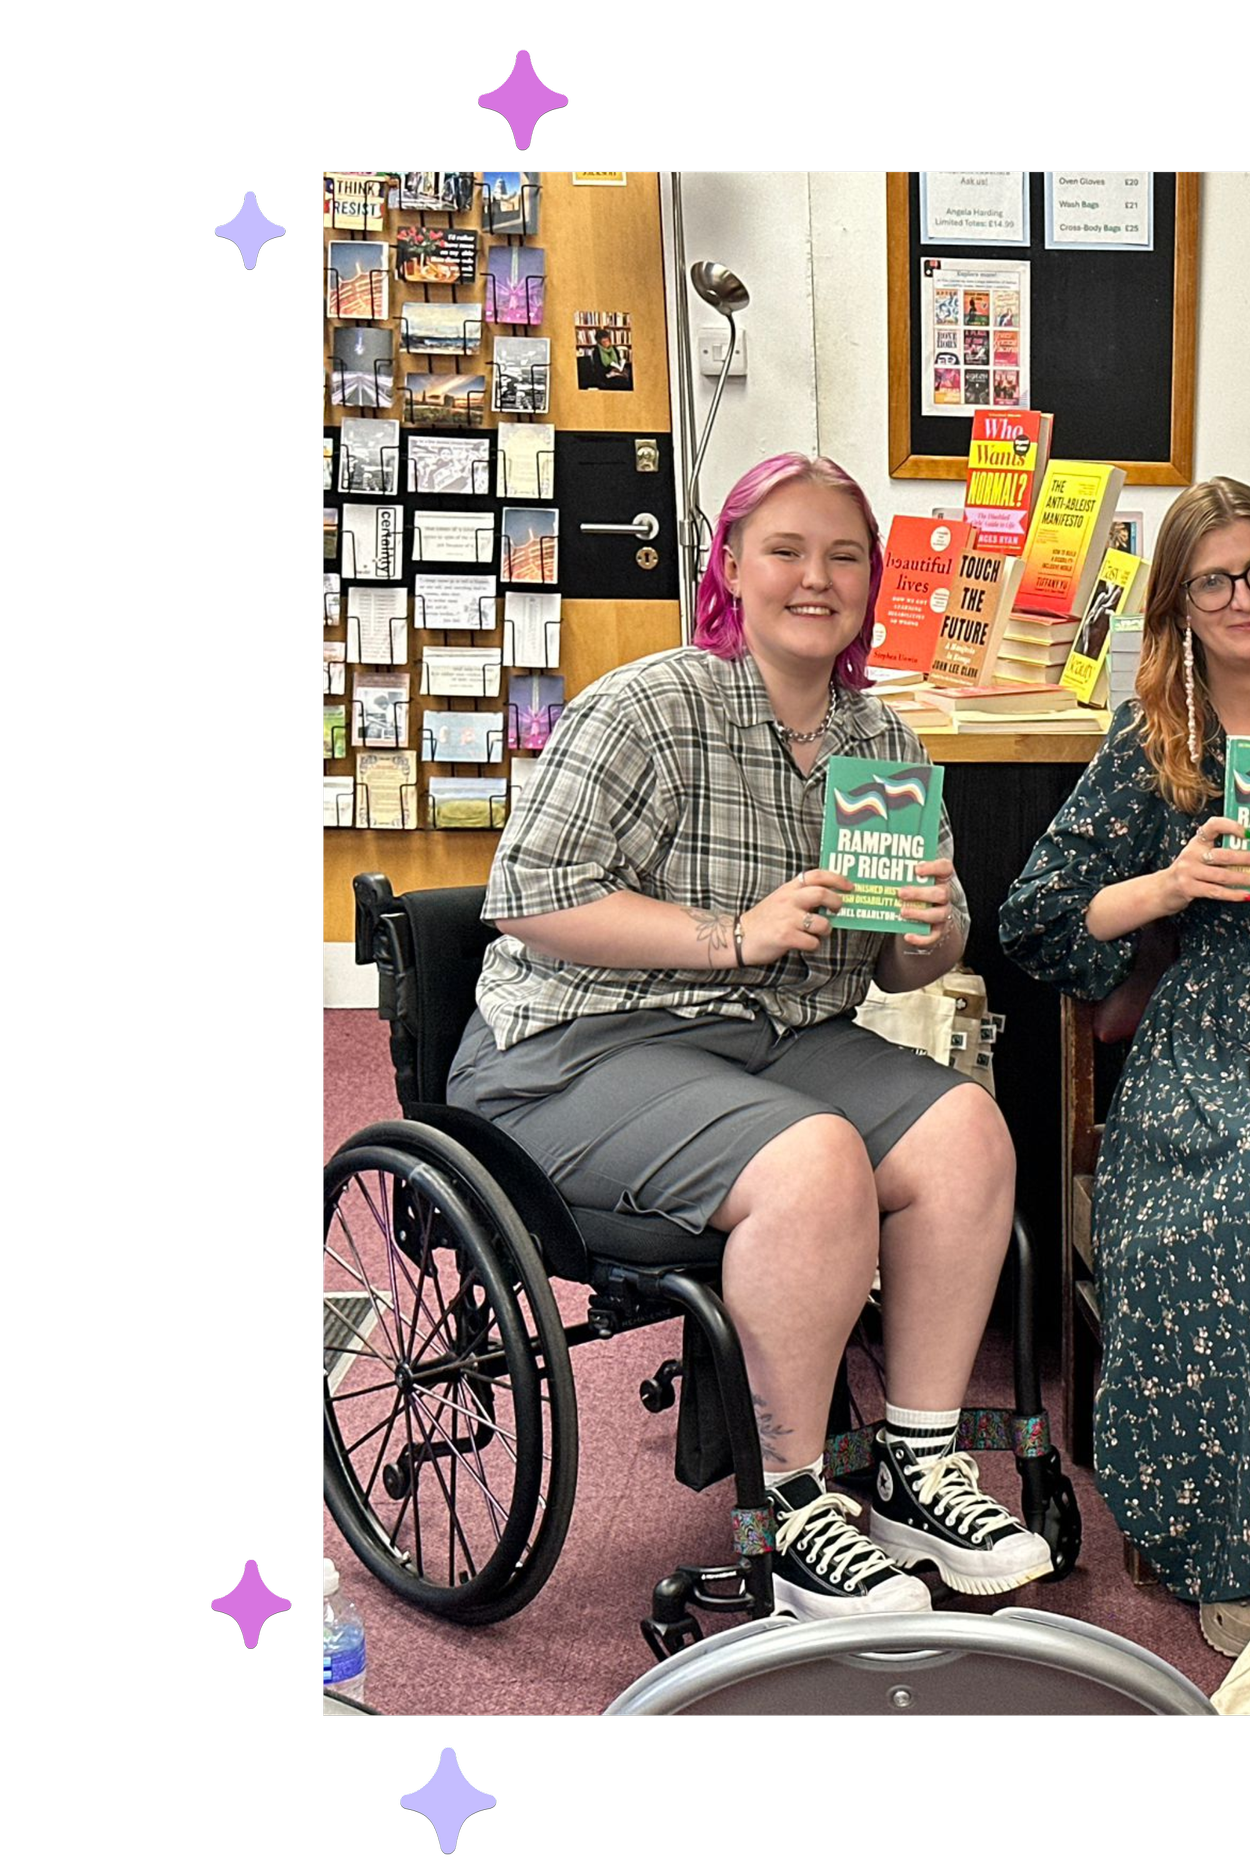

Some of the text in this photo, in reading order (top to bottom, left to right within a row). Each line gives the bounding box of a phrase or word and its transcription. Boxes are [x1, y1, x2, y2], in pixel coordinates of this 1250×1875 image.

[337, 180, 375, 196] THINK
[961, 177, 988, 186] Ask us!
[1080, 178, 1105, 186] Gloves
[1124, 178, 1138, 186] £20
[333, 200, 377, 216] RESIST
[946, 208, 1003, 218] Angela Harding
[1082, 201, 1099, 210] Bags
[935, 218, 963, 226] Limited
[988, 220, 1014, 228] £14.99
[1060, 224, 1138, 233] Cross-Body Bags £25
[985, 418, 1024, 440] Who
[977, 444, 1026, 466] Wants
[967, 471, 1028, 507] NORMAL?
[1051, 480, 1067, 493] THE
[1046, 496, 1096, 512] ANTI-ABLEIST
[1041, 512, 1084, 528] MANIFESTO
[886, 552, 953, 574] beautiful
[960, 555, 1000, 583] TOUCH
[897, 574, 929, 593] lives
[1036, 577, 1059, 588] TIFFANY
[961, 587, 985, 612] THE
[940, 616, 989, 645] FUTURE
[932, 660, 978, 678] JOHN LEE CLARK
[838, 828, 925, 859] RAMPING
[829, 853, 856, 877] UP
